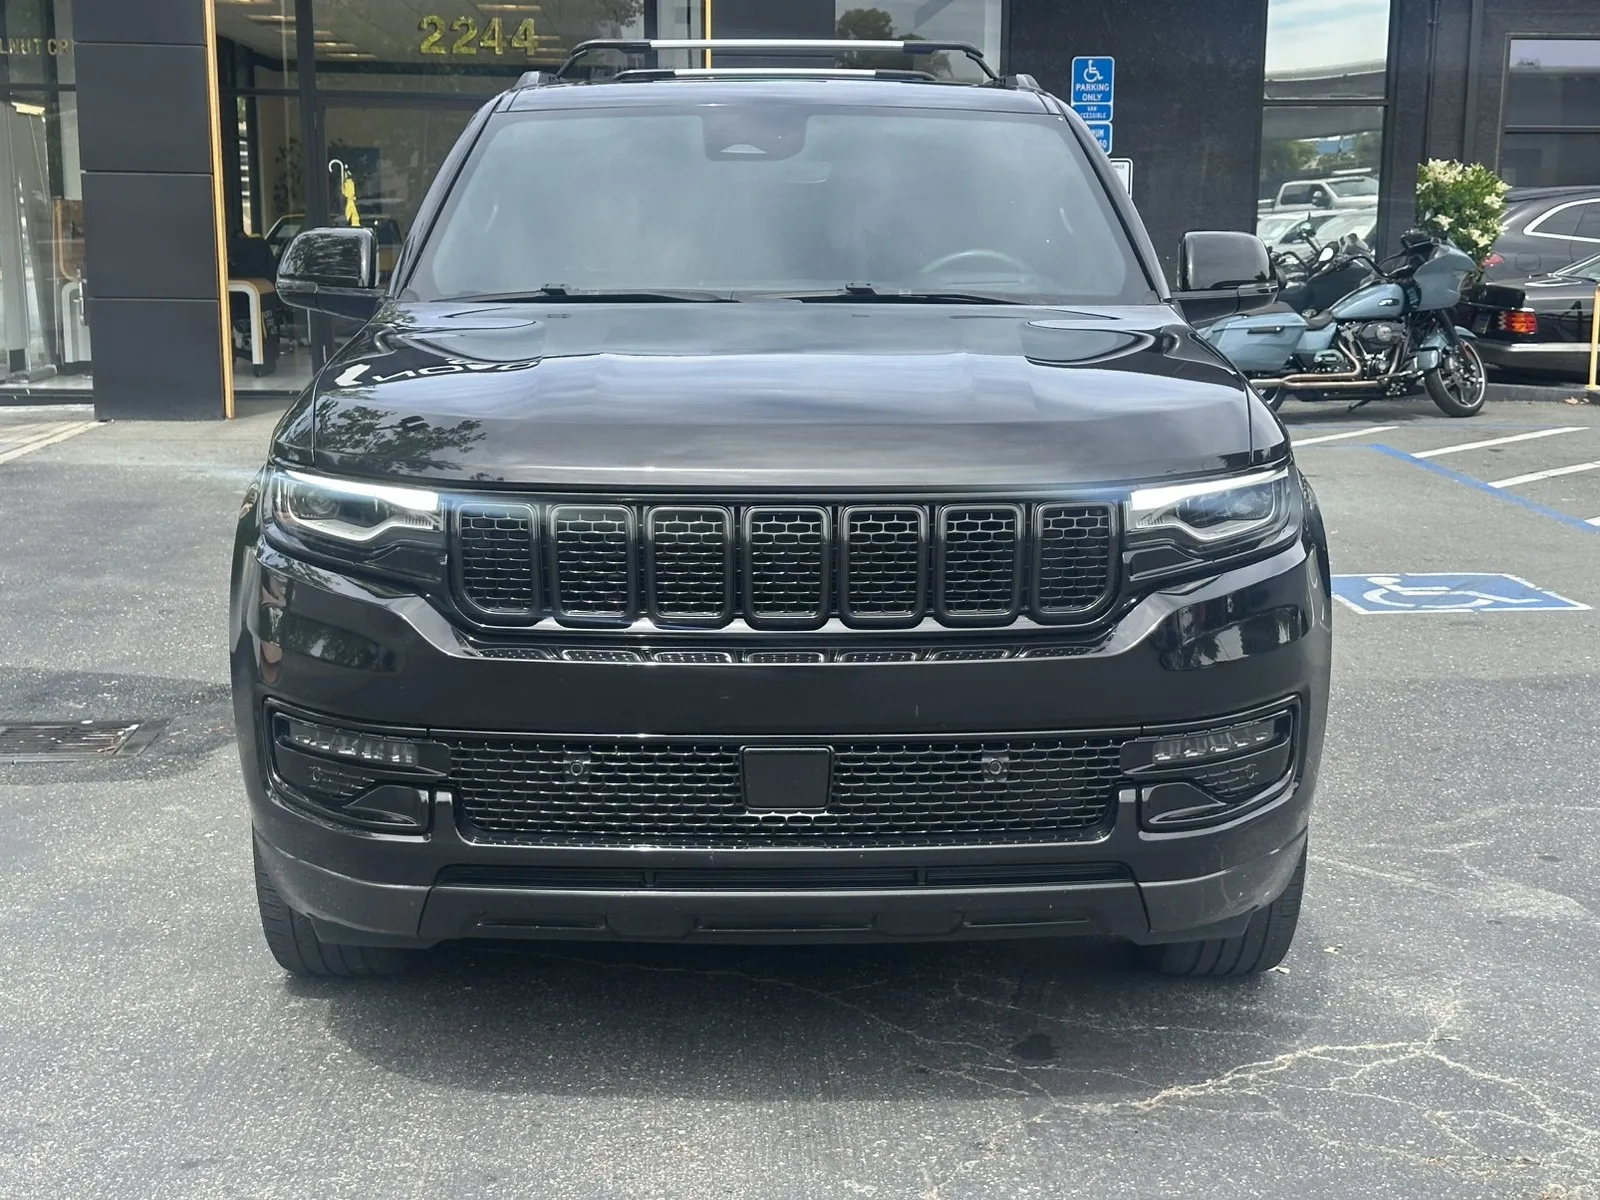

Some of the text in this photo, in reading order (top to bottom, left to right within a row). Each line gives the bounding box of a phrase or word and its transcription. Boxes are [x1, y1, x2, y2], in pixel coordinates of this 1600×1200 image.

[417, 14, 540, 56] 2244
[1075, 83, 1110, 91] PARKING
[1081, 93, 1103, 101] ONLY
